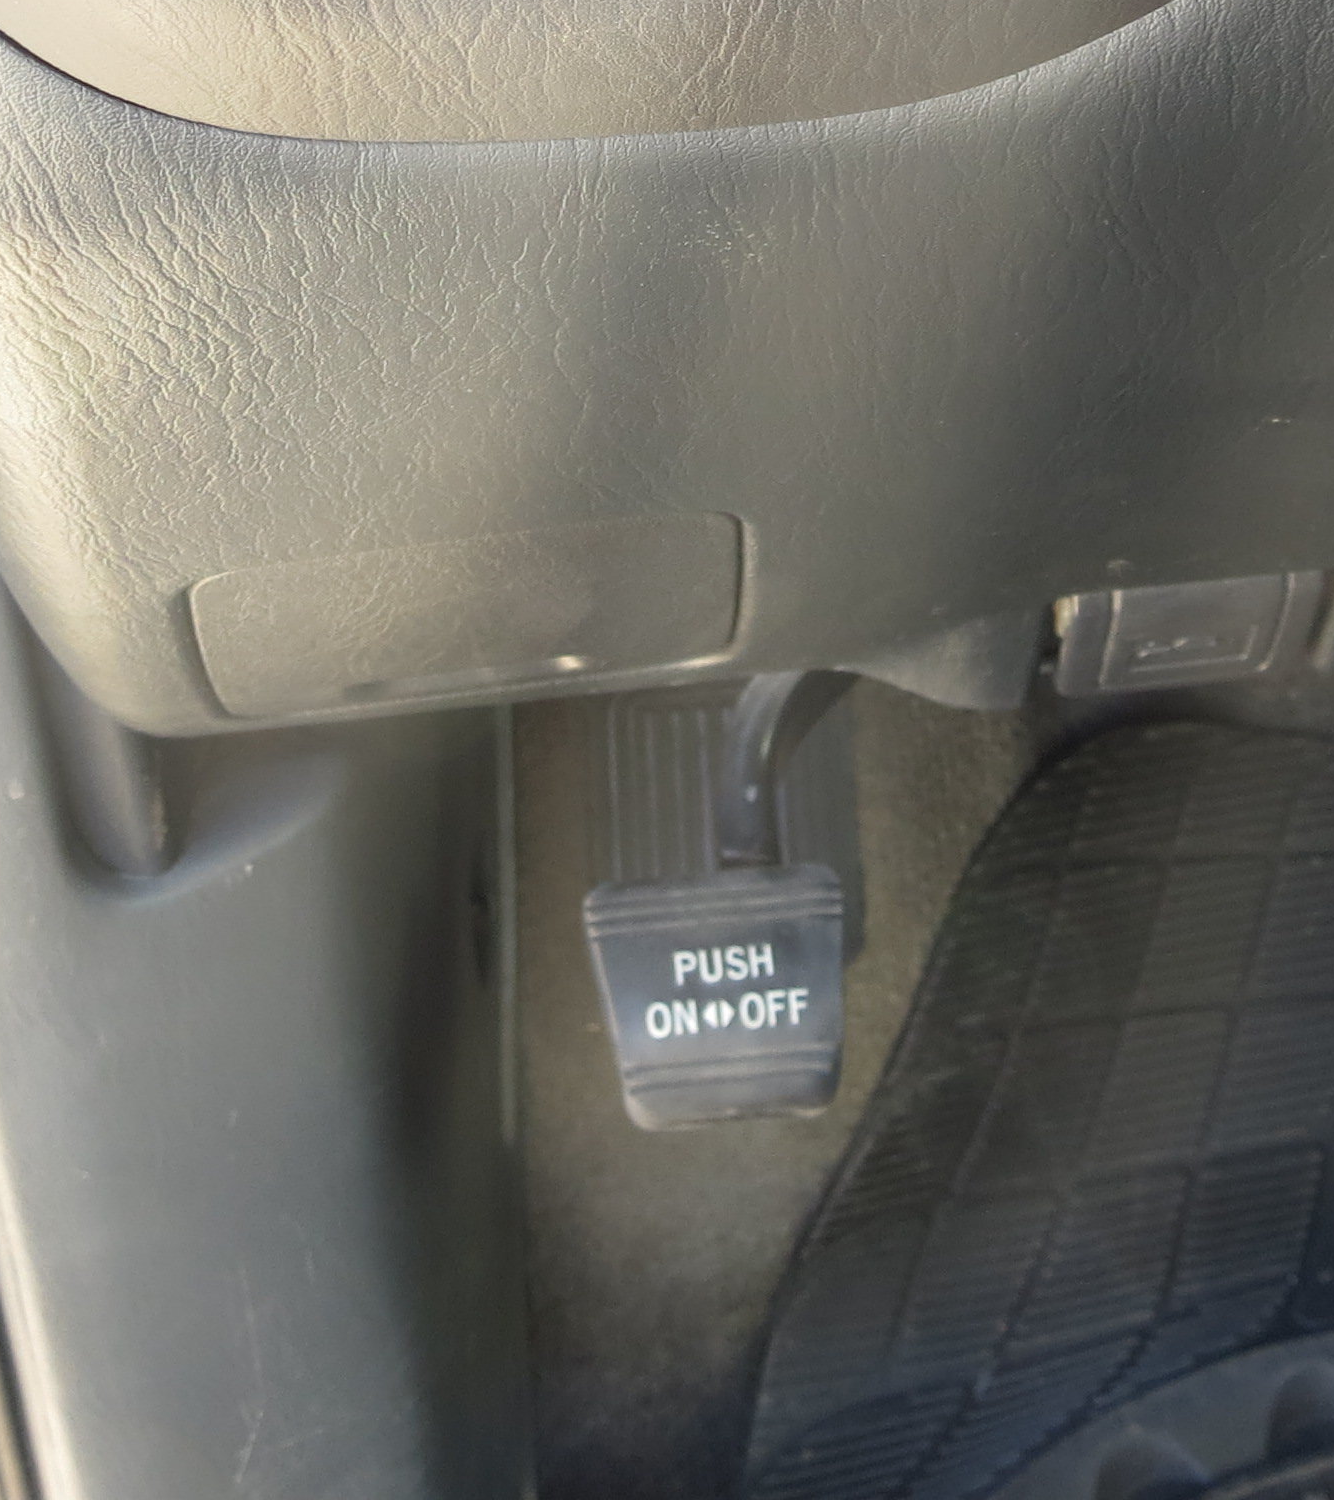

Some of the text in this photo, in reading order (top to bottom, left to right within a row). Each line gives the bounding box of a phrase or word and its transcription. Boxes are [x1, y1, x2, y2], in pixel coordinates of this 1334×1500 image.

[672, 943, 776, 987] PUSH
[645, 987, 810, 1040] ON OFF
